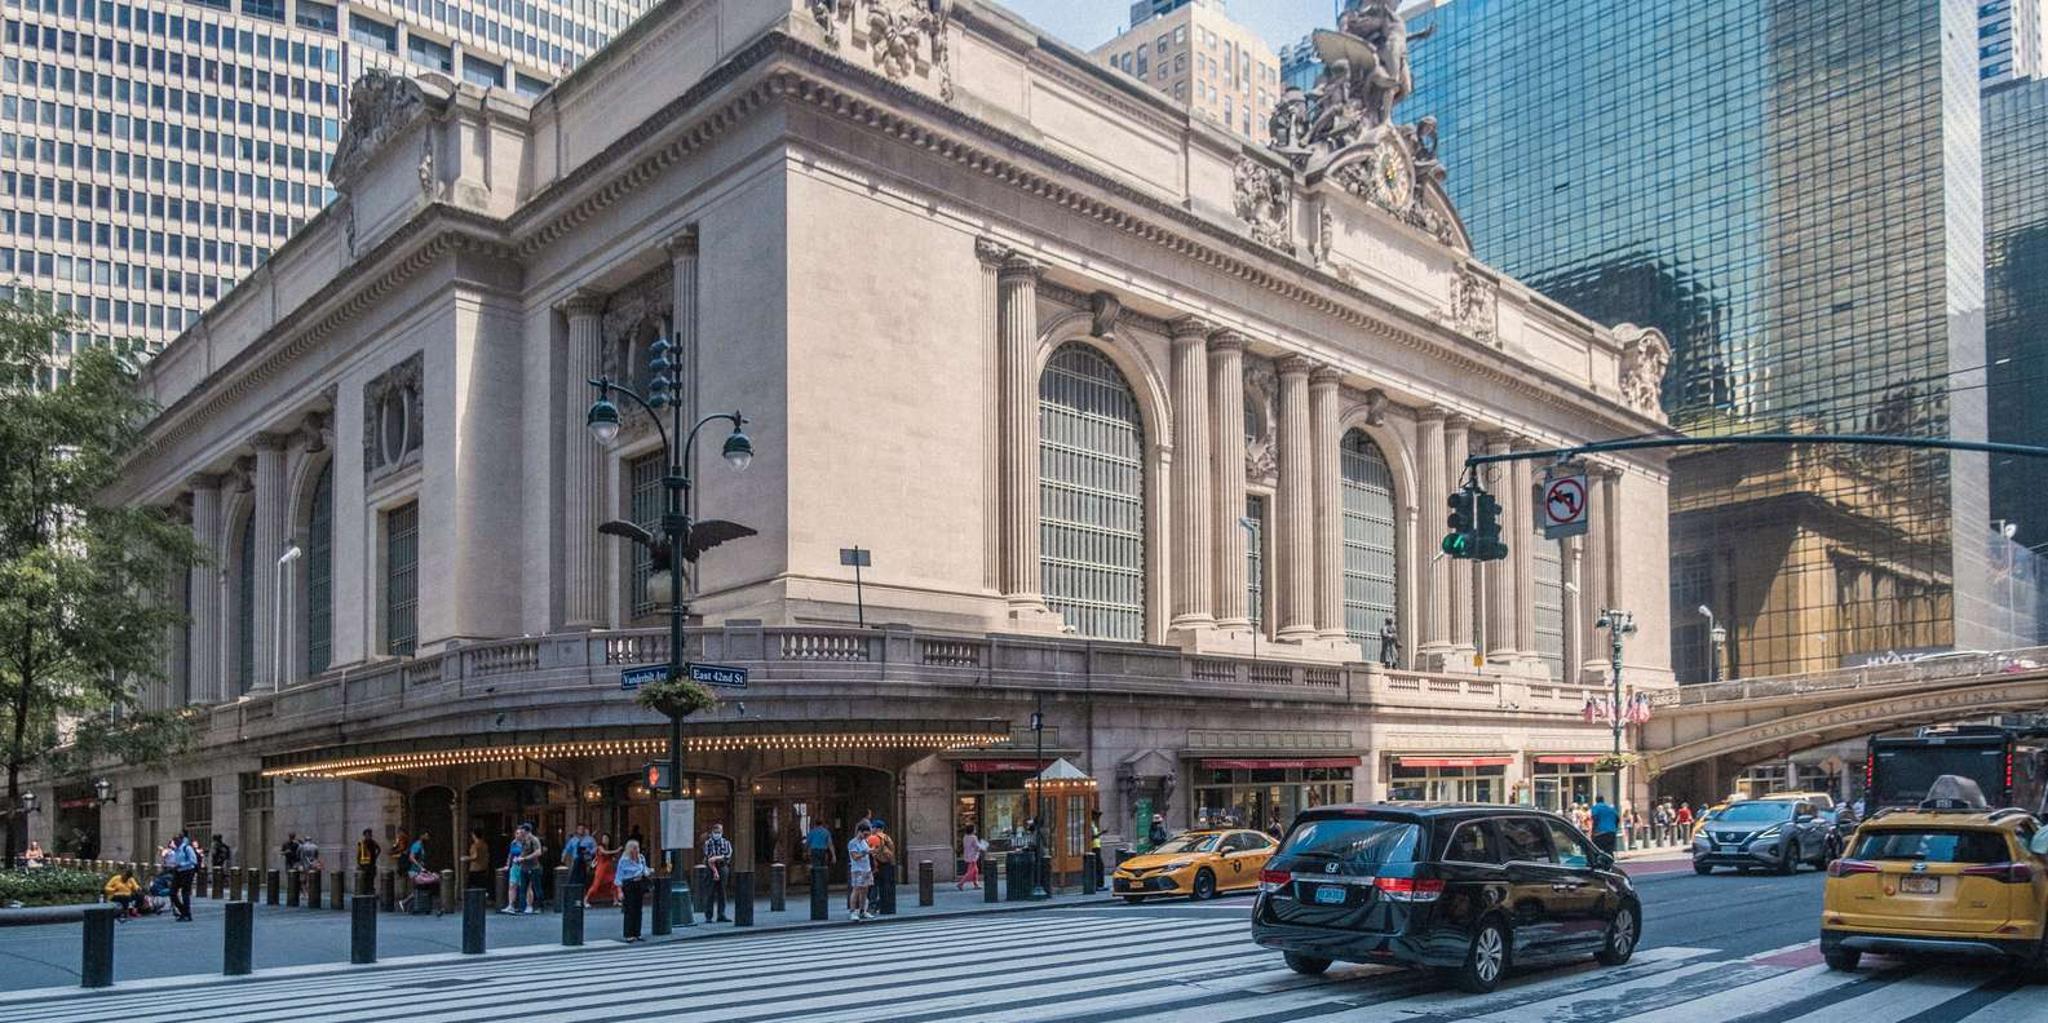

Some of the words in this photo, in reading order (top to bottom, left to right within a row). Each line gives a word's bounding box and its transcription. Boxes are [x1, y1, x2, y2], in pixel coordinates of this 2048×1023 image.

[693, 669, 711, 680] East
[713, 671, 733, 682] 42nd
[734, 673, 743, 684] St
[1750, 721, 1806, 739] GRAND
[1817, 703, 1897, 724] CENTRAL
[1911, 690, 2008, 709] TERMINAL
